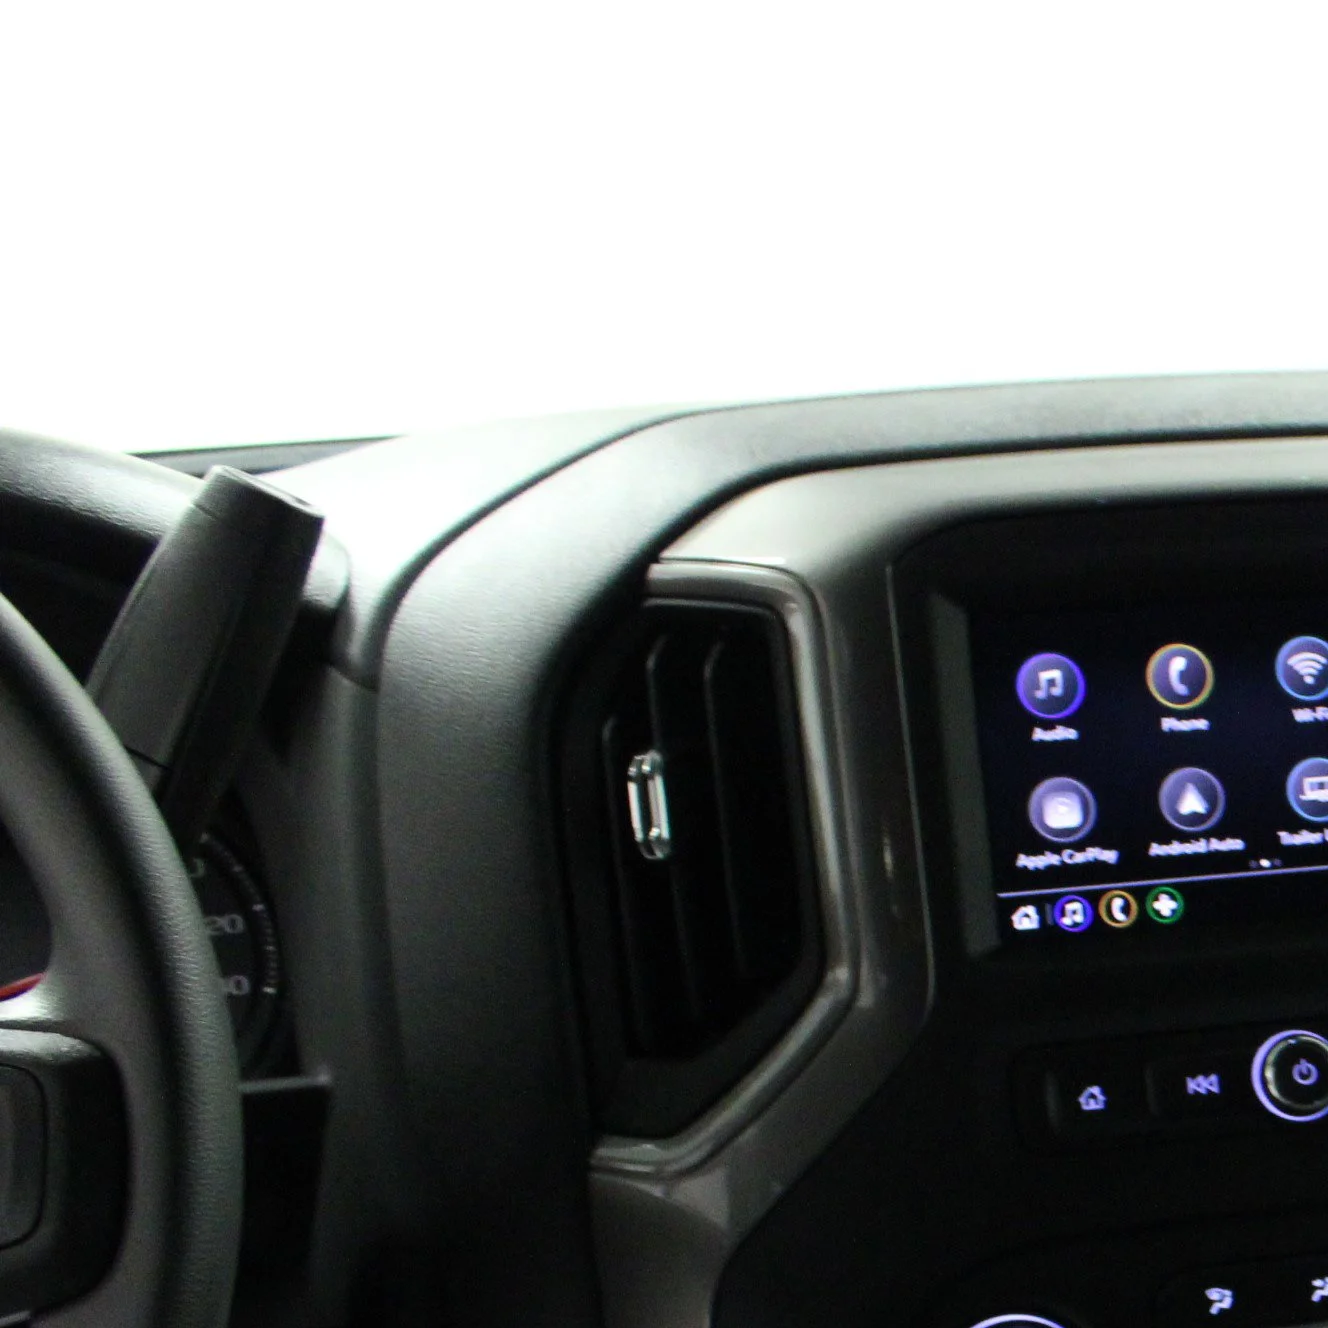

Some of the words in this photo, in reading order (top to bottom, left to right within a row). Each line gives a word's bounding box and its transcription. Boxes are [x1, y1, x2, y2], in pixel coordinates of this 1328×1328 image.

[1160, 716, 1210, 732] Phone
[1031, 725, 1079, 742] Audio
[1148, 838, 1207, 856] Android
[1208, 837, 1246, 854] Auto
[1016, 851, 1061, 871] Apple
[1062, 847, 1120, 865] CarPlay
